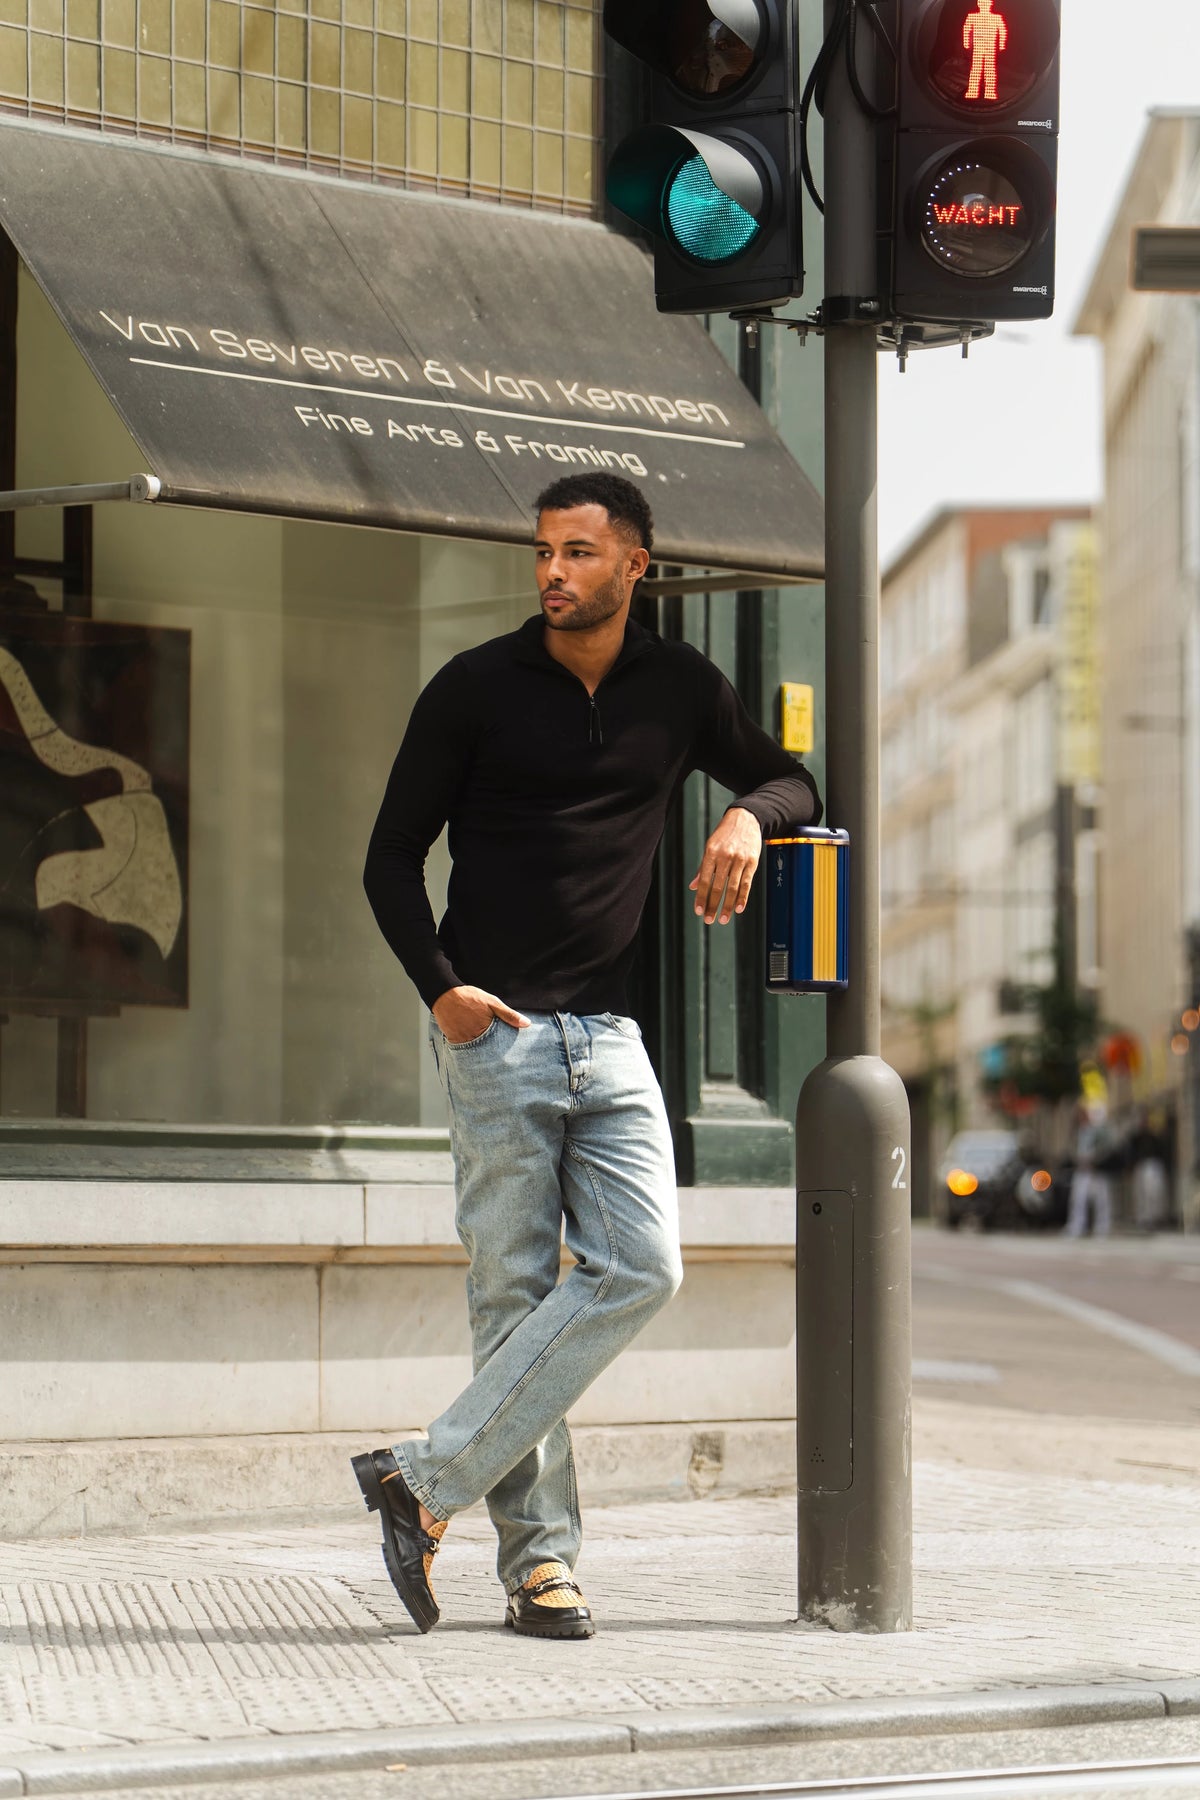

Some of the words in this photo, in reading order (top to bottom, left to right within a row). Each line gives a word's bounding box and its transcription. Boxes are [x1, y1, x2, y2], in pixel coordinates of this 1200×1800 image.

[933, 203, 1021, 225] WACHT
[99, 310, 200, 351] Van
[209, 329, 410, 382] Severen
[423, 359, 457, 389] &
[457, 365, 552, 403] Van
[555, 379, 731, 427] Kempen
[294, 406, 374, 436] Fine
[387, 419, 464, 448] Arts
[475, 430, 501, 453] &
[504, 434, 649, 477] Framing
[891, 1146, 906, 1189] 2
